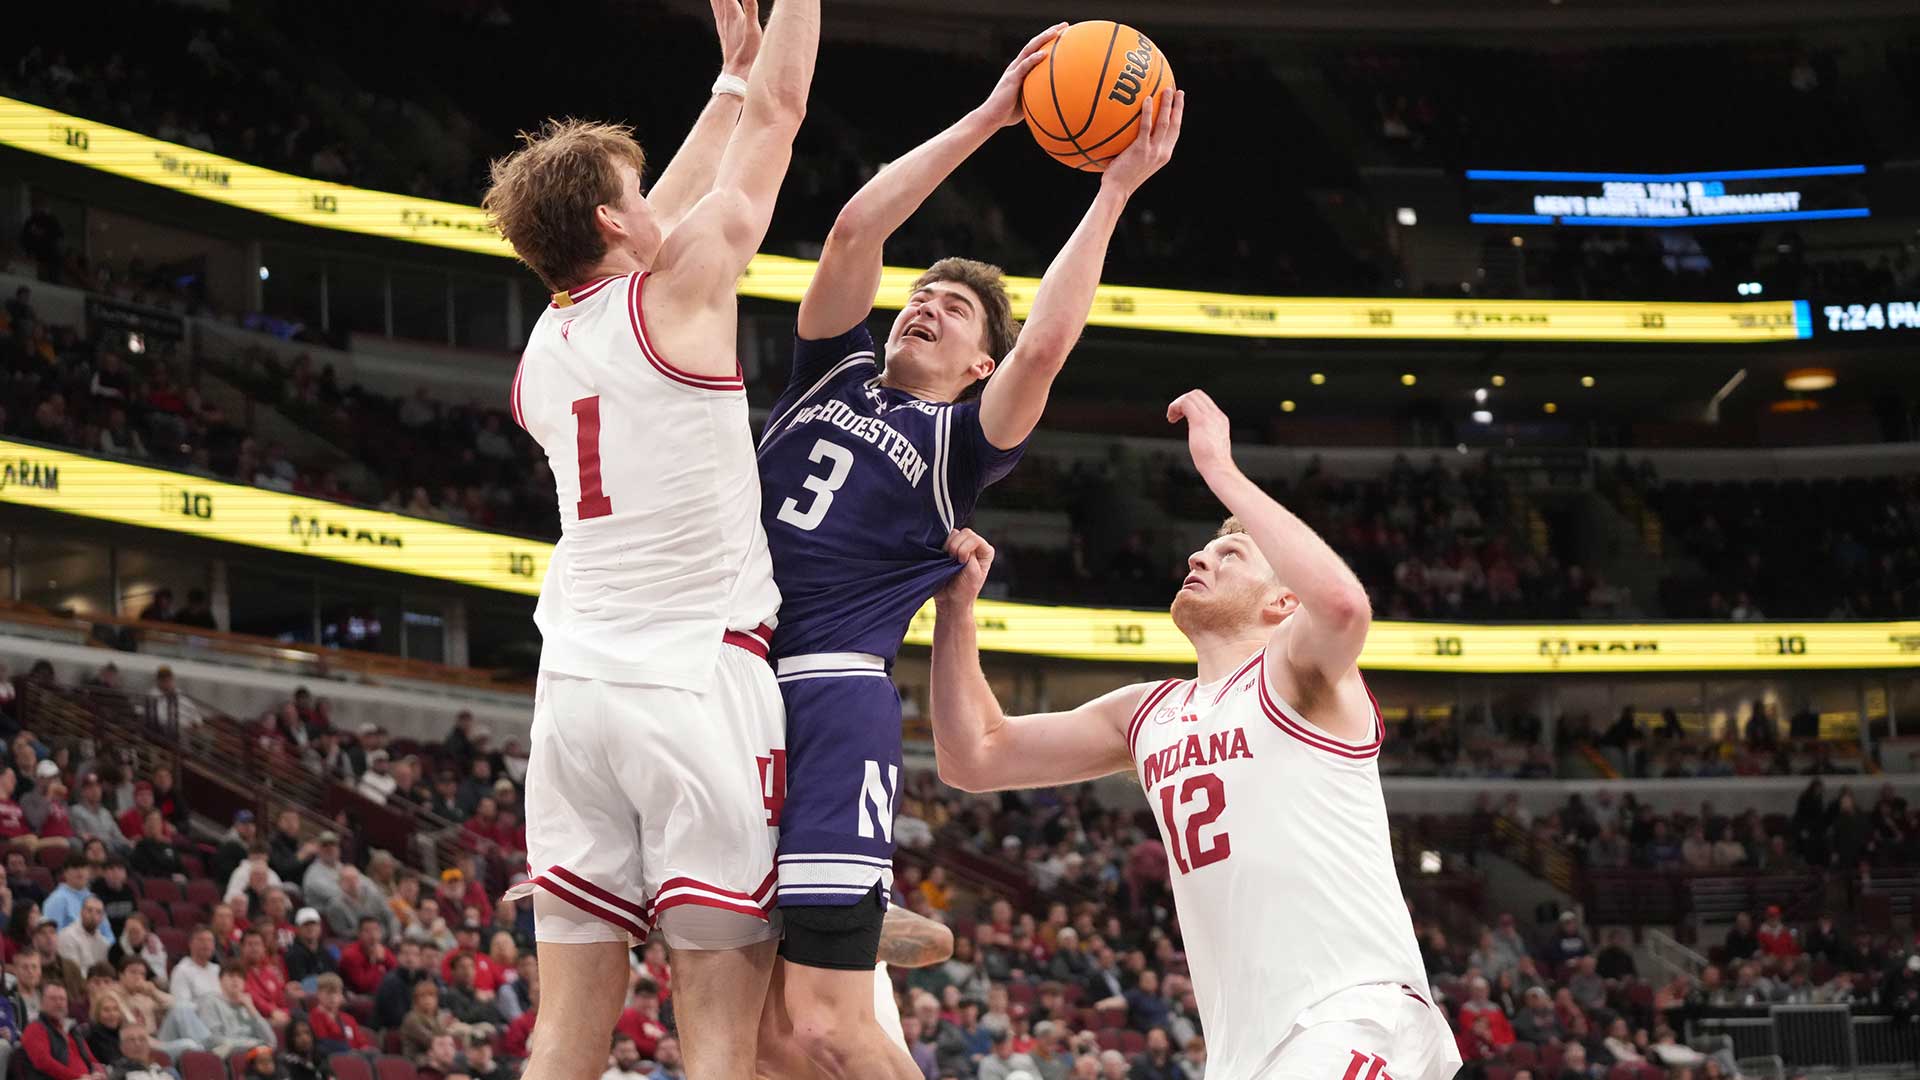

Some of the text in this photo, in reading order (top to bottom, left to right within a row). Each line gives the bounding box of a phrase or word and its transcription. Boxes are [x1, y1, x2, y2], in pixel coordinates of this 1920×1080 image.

[1823, 302, 1885, 331] 7:24
[19, 460, 60, 493] RAM
[572, 395, 613, 520] 1
[776, 438, 855, 532] 3
[858, 760, 898, 843] N
[1143, 727, 1254, 793] INDANA
[1159, 772, 1232, 875] 12
